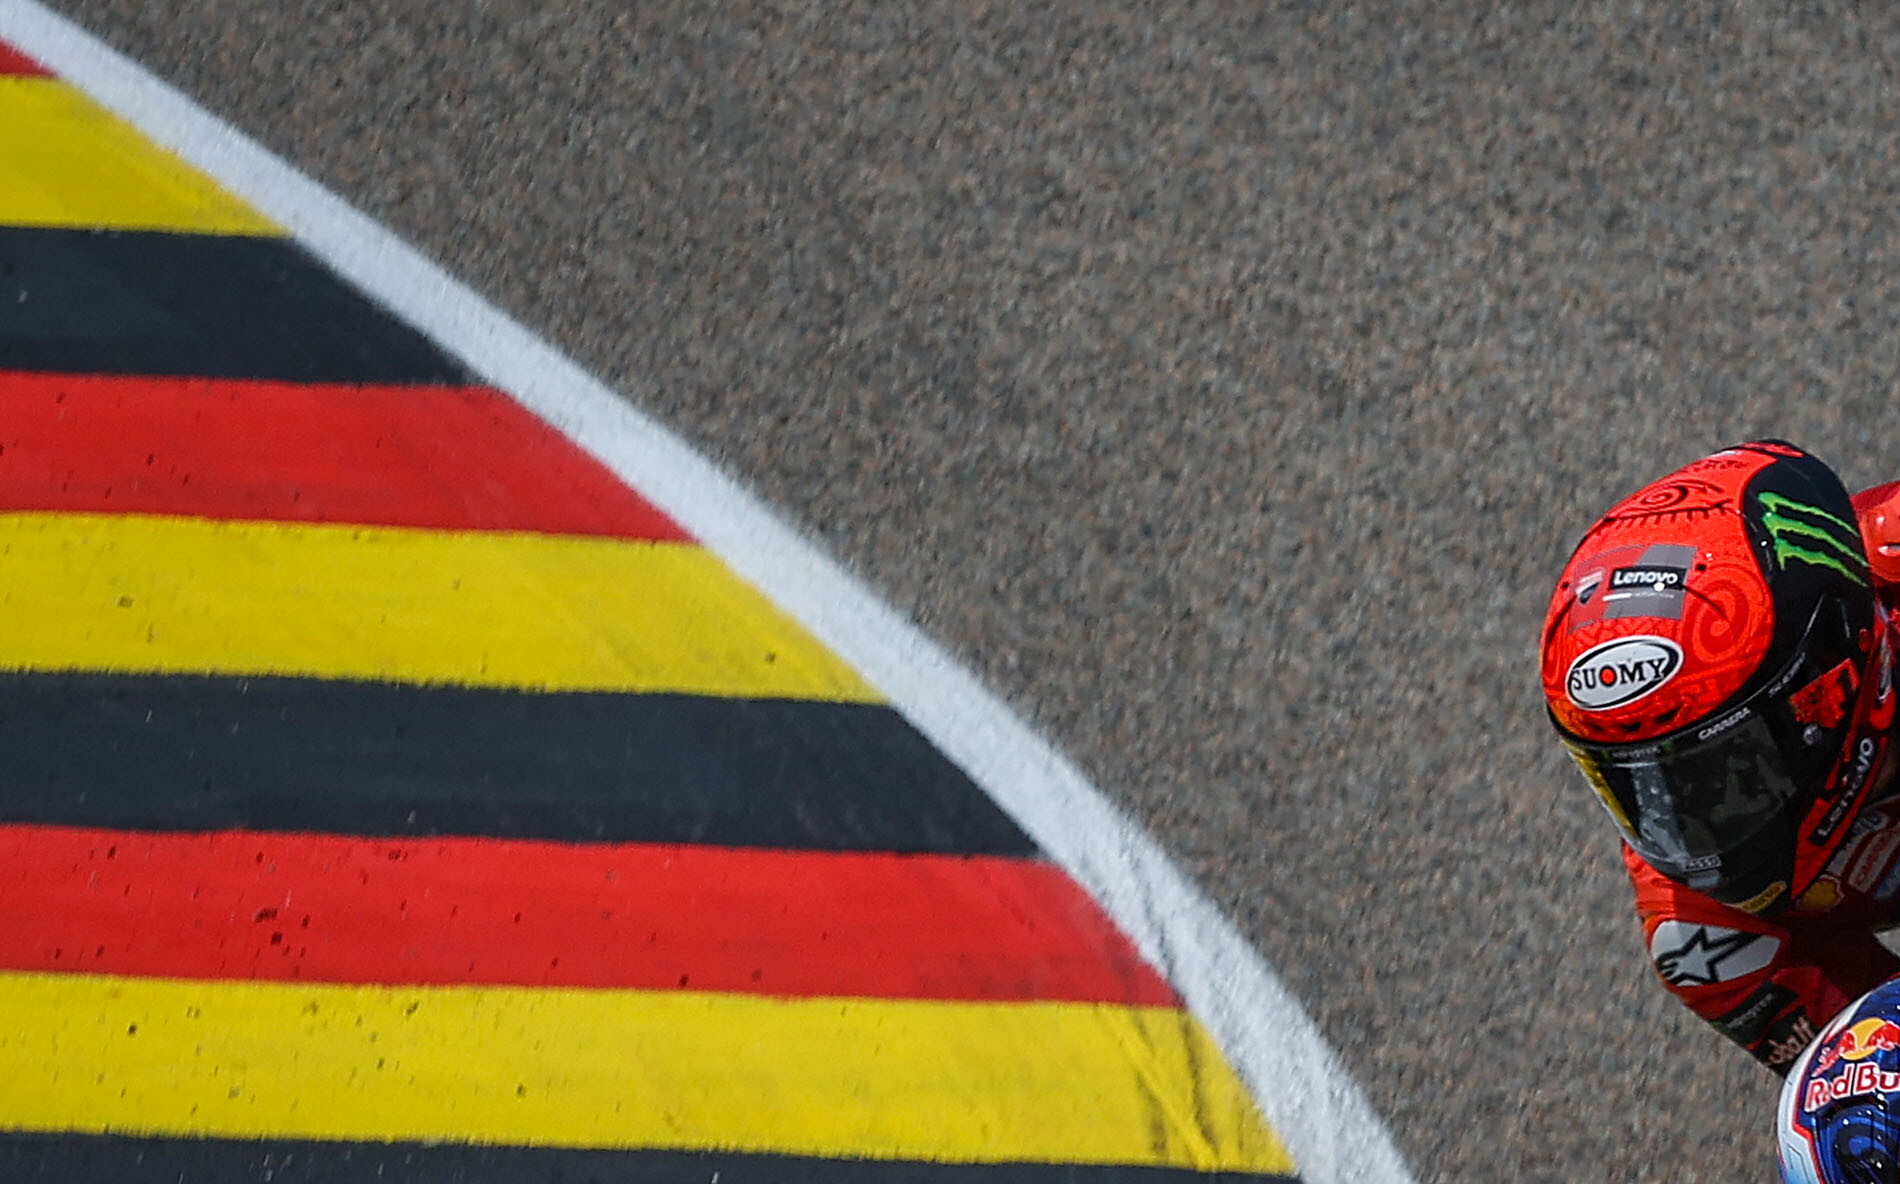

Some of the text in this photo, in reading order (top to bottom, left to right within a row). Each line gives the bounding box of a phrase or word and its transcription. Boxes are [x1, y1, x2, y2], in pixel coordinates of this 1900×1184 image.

[1612, 568, 1679, 587] Lenovo
[1570, 657, 1667, 691] SUOMY
[1698, 706, 1751, 740] CARRERA
